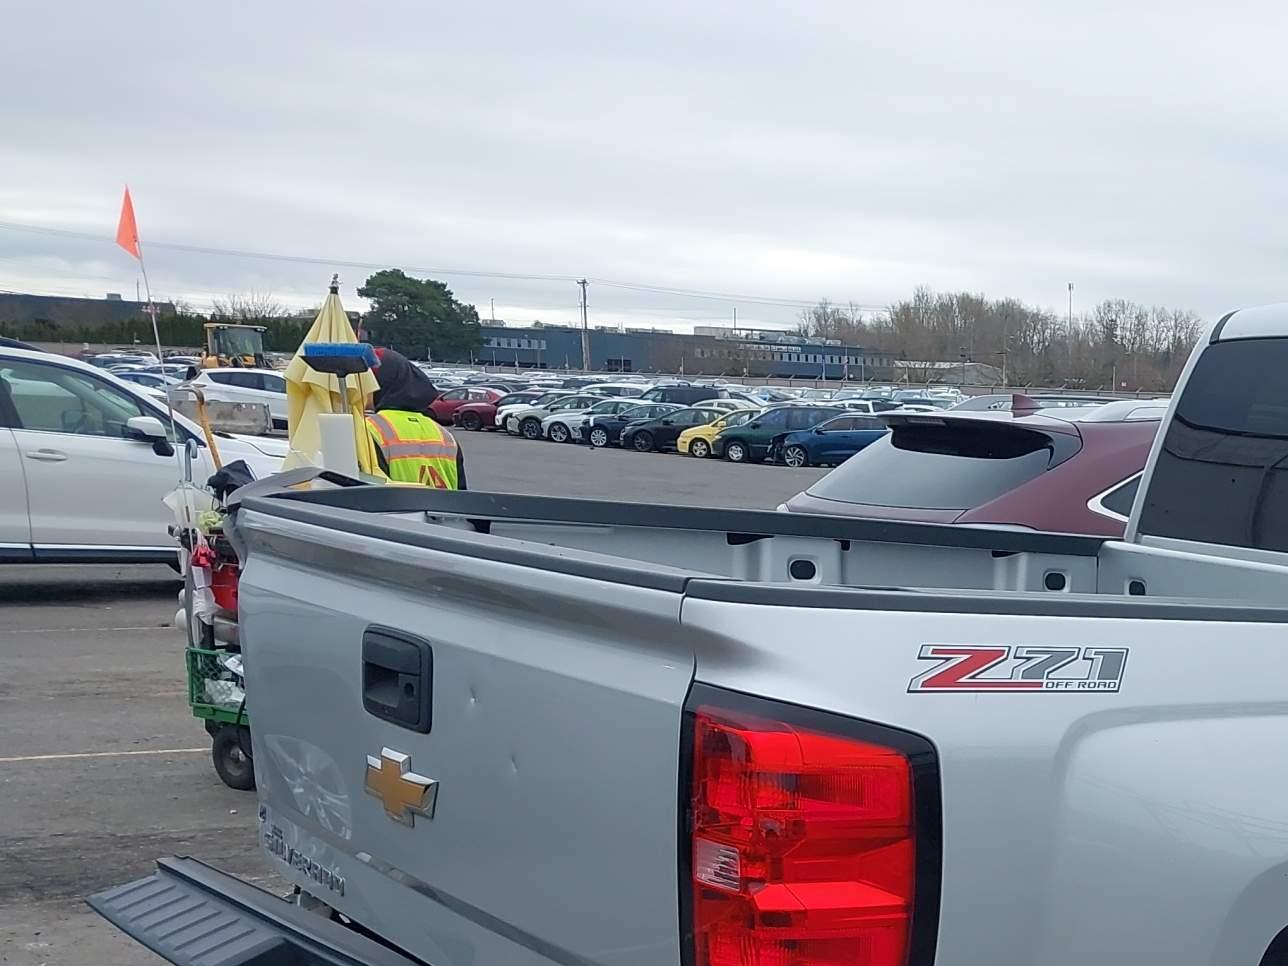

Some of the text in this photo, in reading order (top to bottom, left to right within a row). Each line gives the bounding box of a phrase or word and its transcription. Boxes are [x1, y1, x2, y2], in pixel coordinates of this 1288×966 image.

[906, 643, 1130, 694] Z71
[1045, 681, 1118, 689] OFF ROAD
